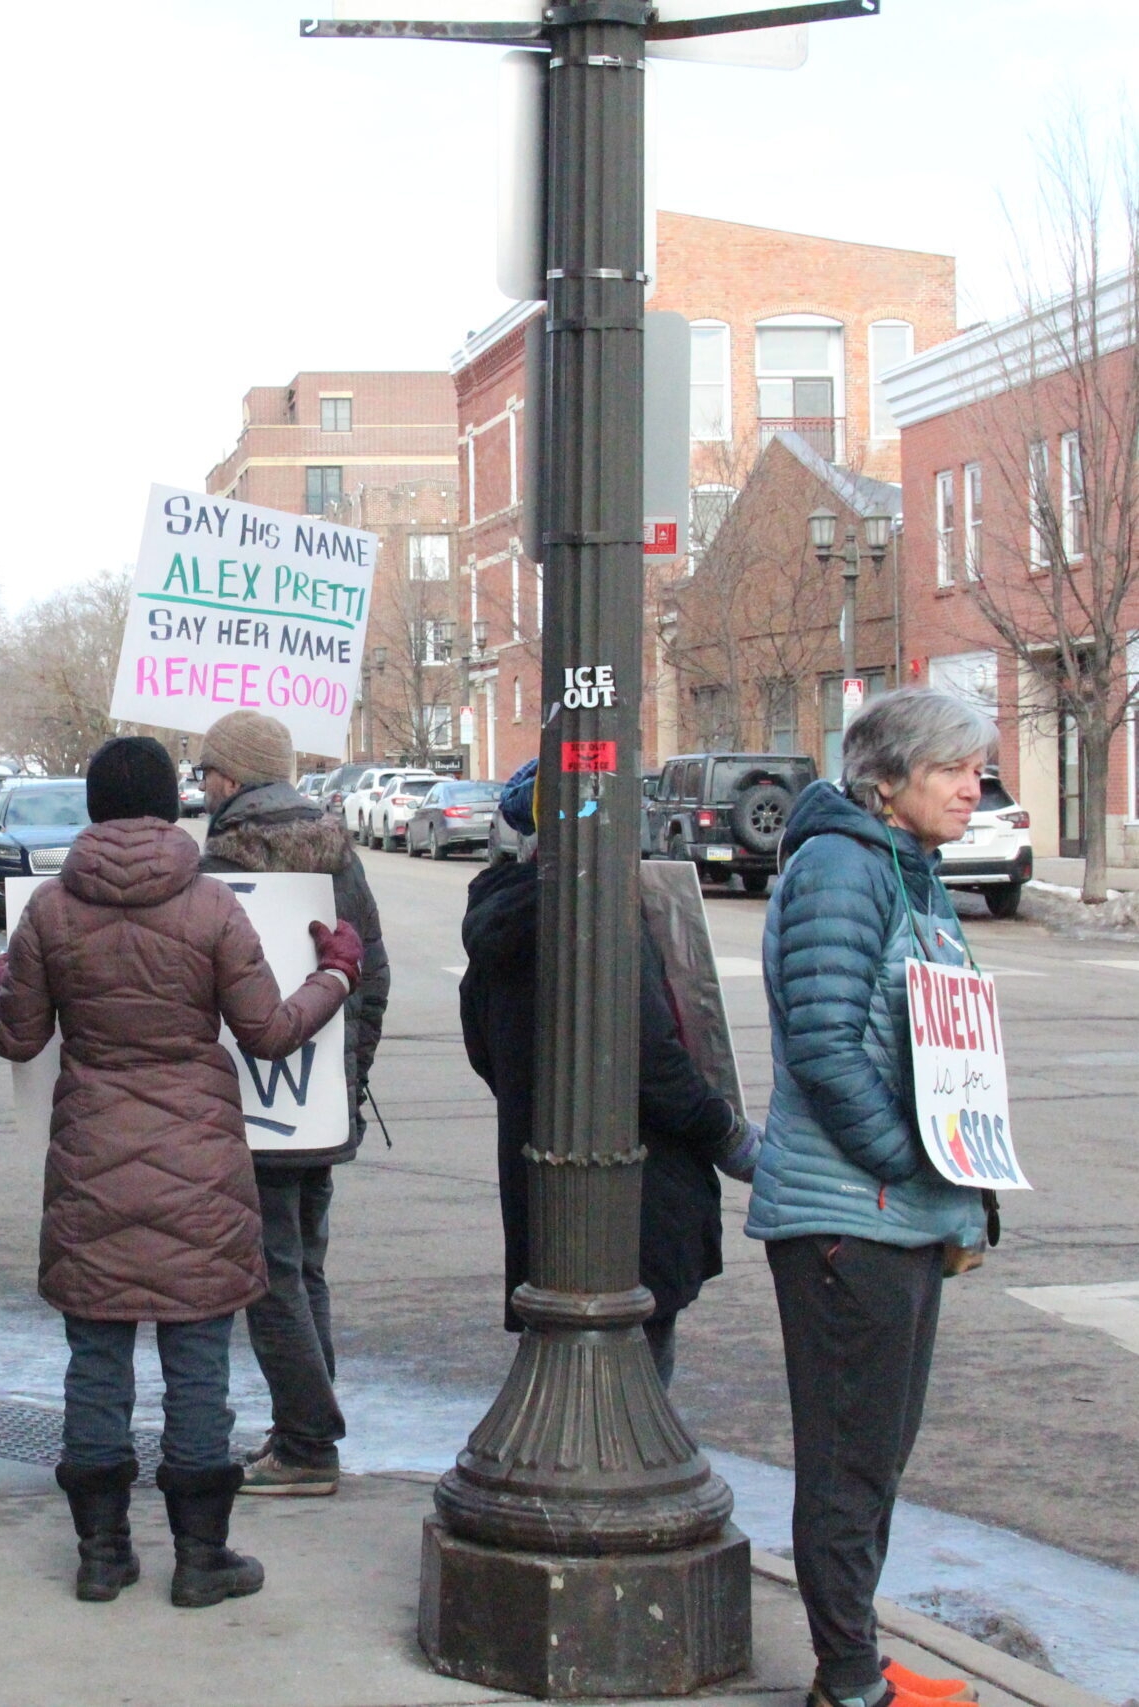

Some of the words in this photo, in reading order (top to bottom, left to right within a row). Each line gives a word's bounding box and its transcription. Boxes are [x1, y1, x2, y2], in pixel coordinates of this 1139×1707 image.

[164, 495, 230, 538] SAY
[239, 513, 281, 550] HIS
[294, 524, 370, 567] NAME
[162, 552, 262, 601] ALEX
[274, 564, 365, 621] PRETTI
[148, 608, 207, 645] SAY
[216, 618, 270, 649] HER
[279, 624, 351, 664] NAME
[136, 655, 261, 708] RENEE
[267, 665, 348, 717] GOOD
[563, 686, 616, 709] OUT
[564, 664, 614, 689] ICE
[908, 964, 999, 1055] CRUELTY
[933, 1055, 955, 1095] is
[961, 1058, 991, 1104] for
